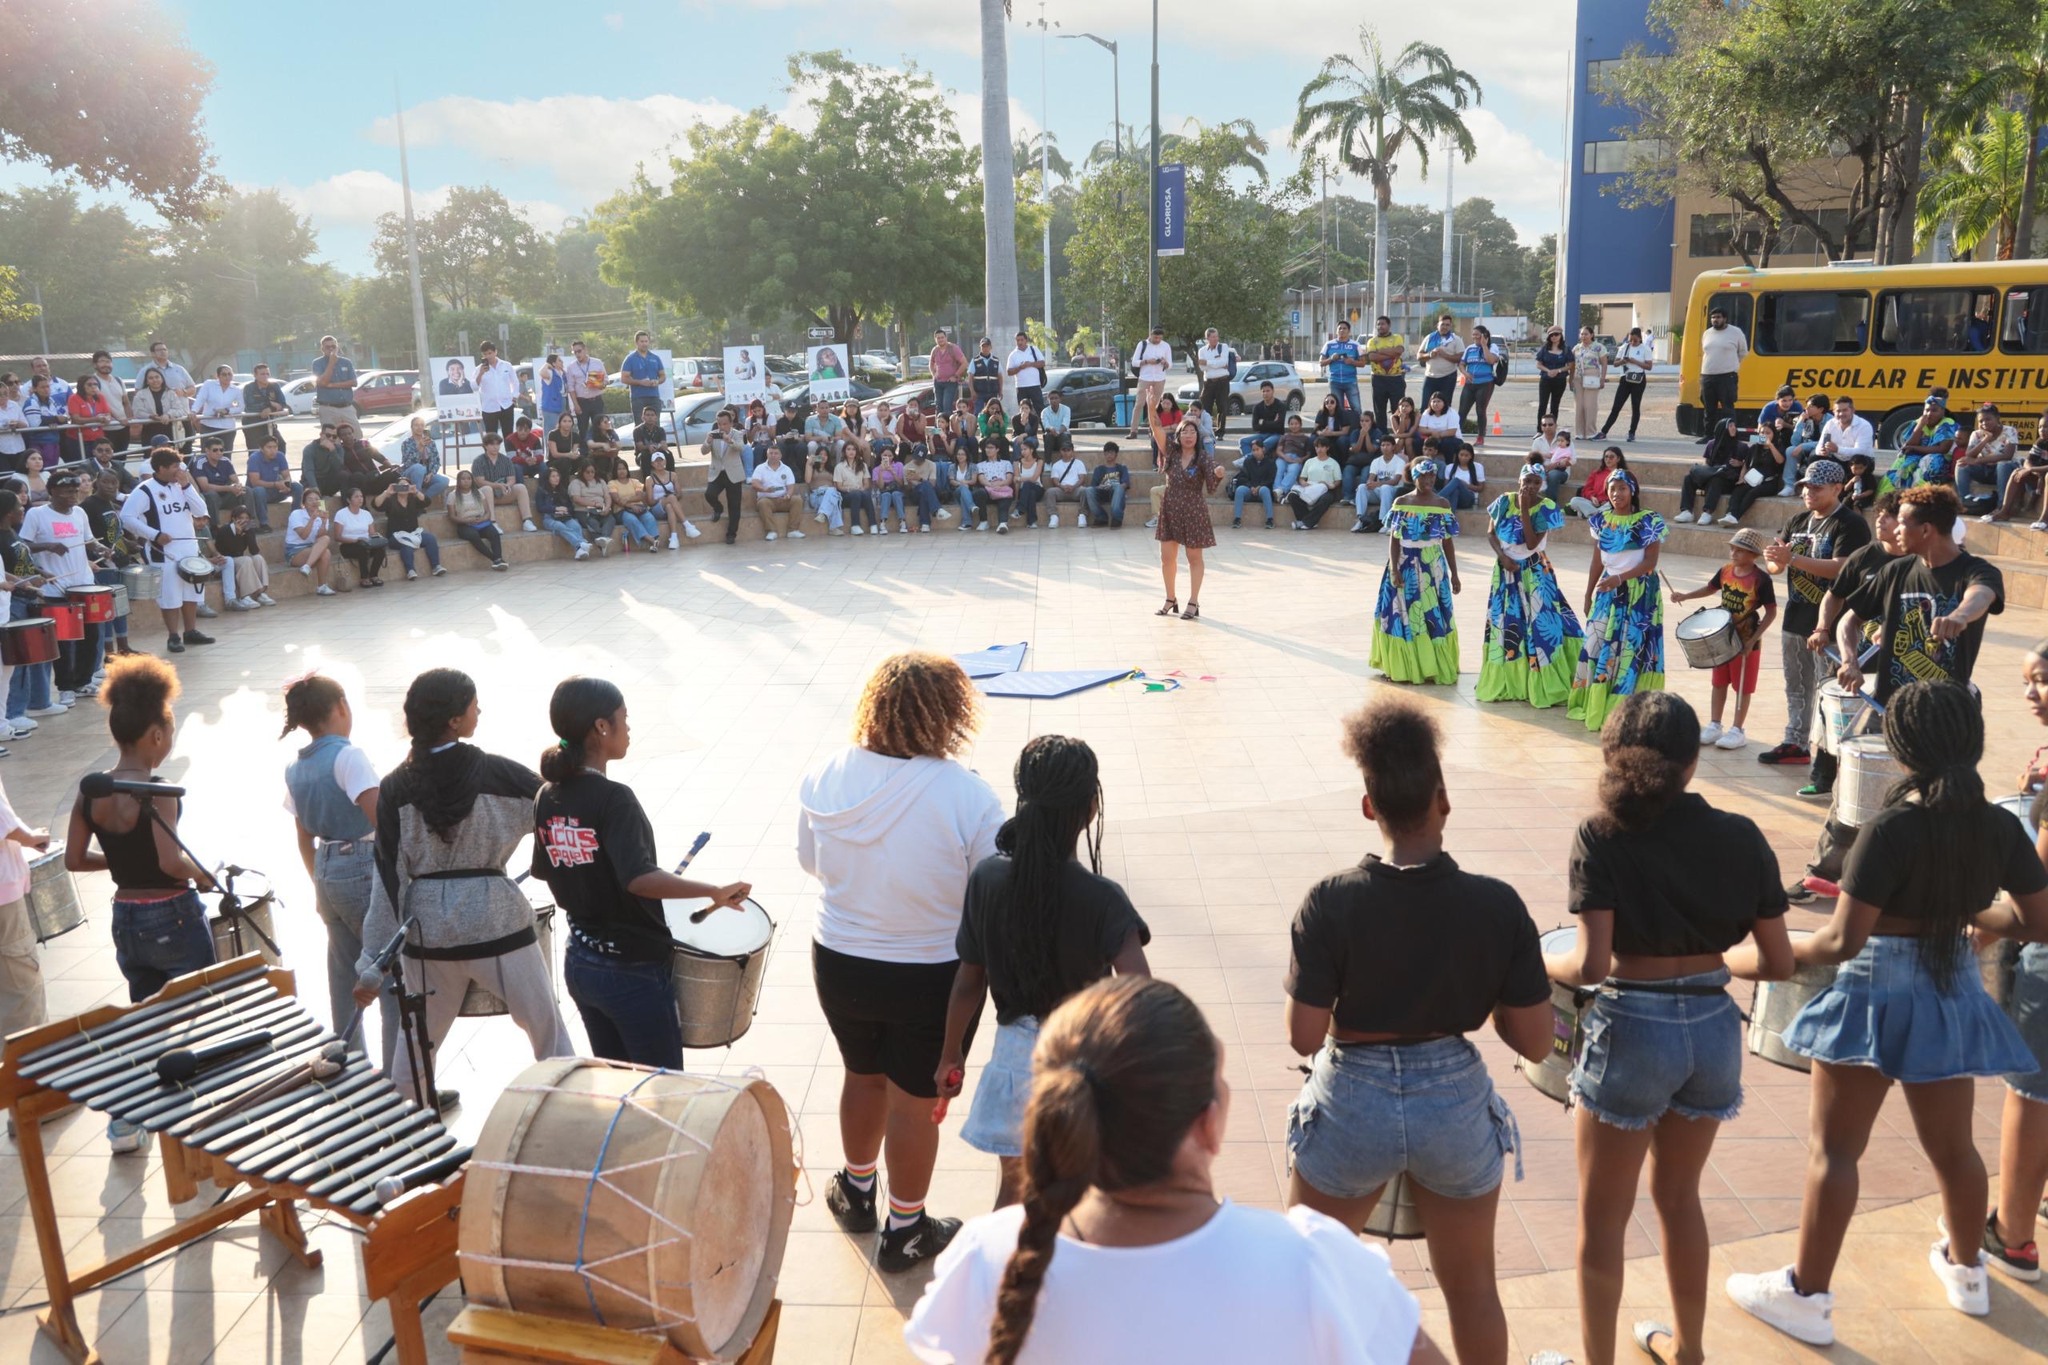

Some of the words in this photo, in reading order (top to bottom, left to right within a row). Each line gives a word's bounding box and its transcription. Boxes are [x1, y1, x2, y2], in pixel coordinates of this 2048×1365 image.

[1164, 187, 1172, 237] GLORIOSA
[1785, 368, 1907, 389] ESCOLAR
[1916, 368, 1937, 389] E
[162, 501, 191, 515] USA
